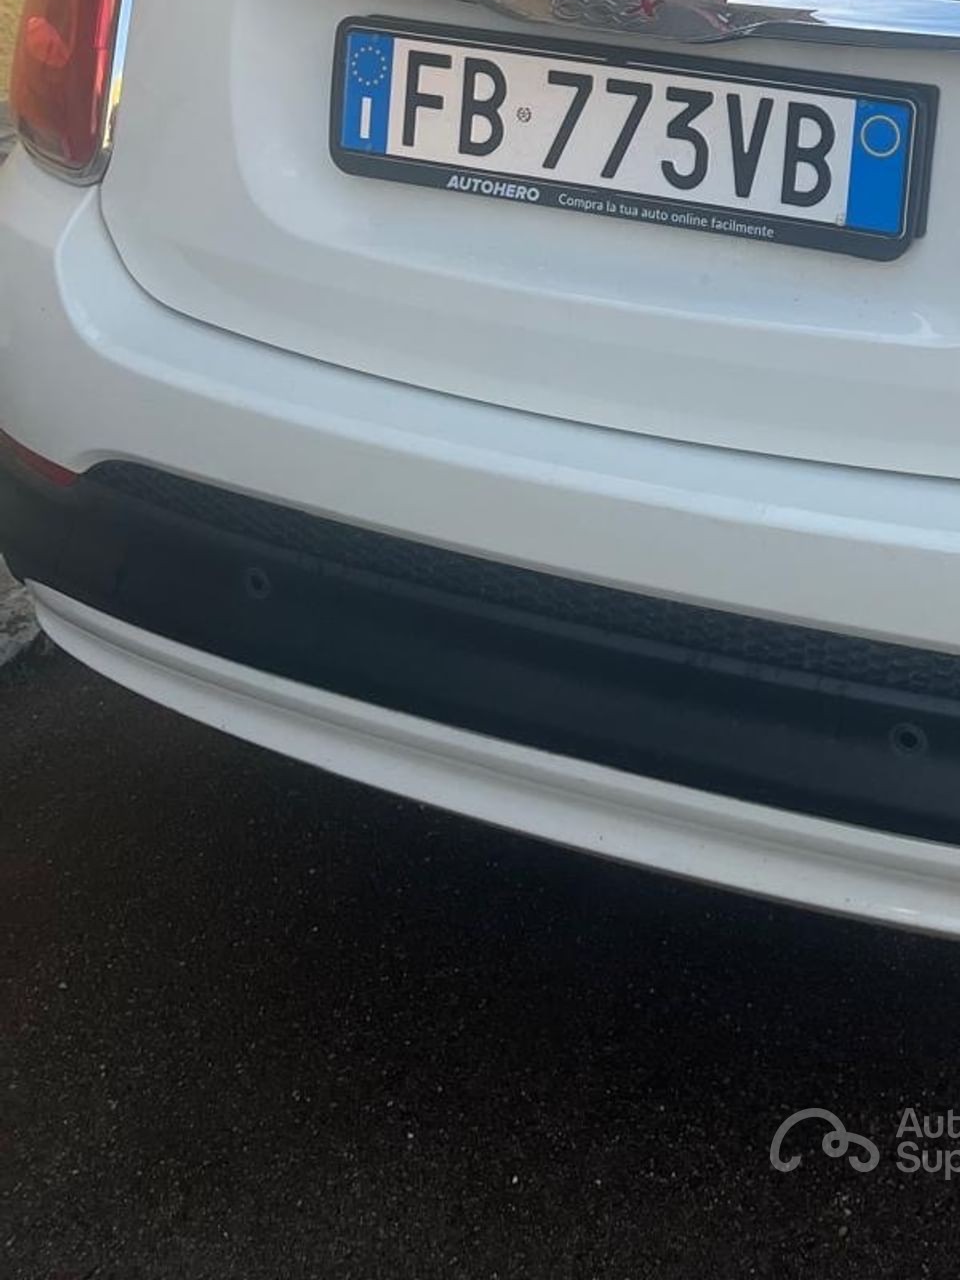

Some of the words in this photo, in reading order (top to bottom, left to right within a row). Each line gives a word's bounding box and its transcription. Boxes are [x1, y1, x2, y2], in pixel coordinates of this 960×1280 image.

[447, 174, 541, 203] AUTOHERO
[558, 192, 603, 212] Compra
[606, 200, 617, 213] la
[619, 203, 639, 218] tua
[641, 206, 669, 222] auto
[671, 210, 709, 229] online
[711, 217, 774, 239] facilmente
